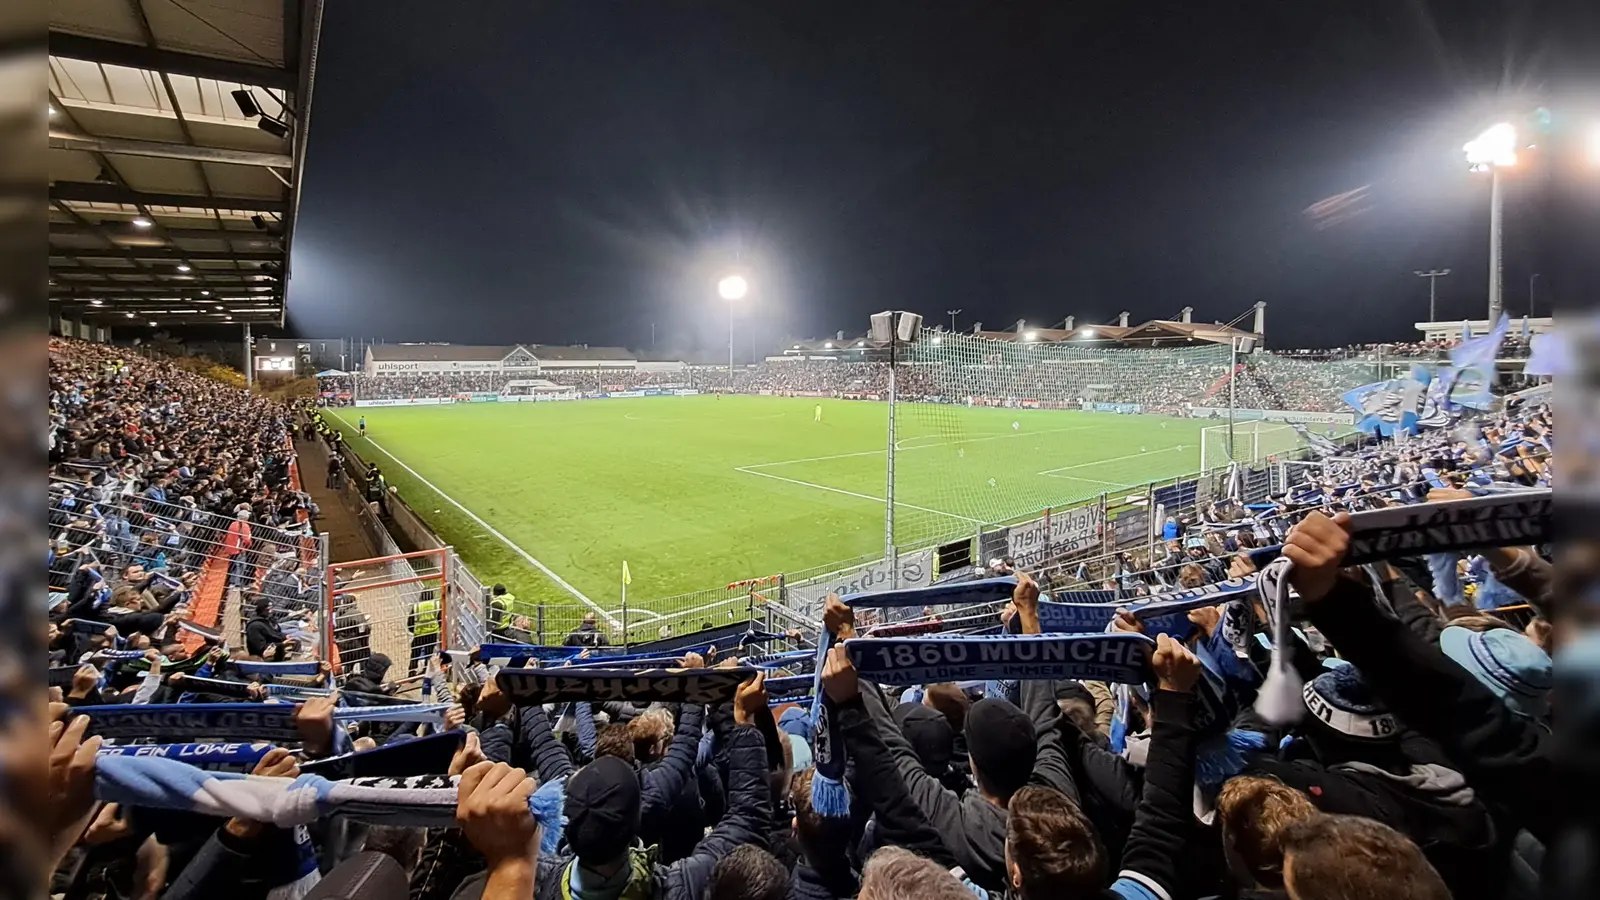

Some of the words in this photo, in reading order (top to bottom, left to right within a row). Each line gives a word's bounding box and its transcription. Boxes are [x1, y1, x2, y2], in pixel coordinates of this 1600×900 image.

[378, 362, 418, 371] uhlsport
[876, 642, 967, 668] 1860
[134, 746, 172, 757] EIN
